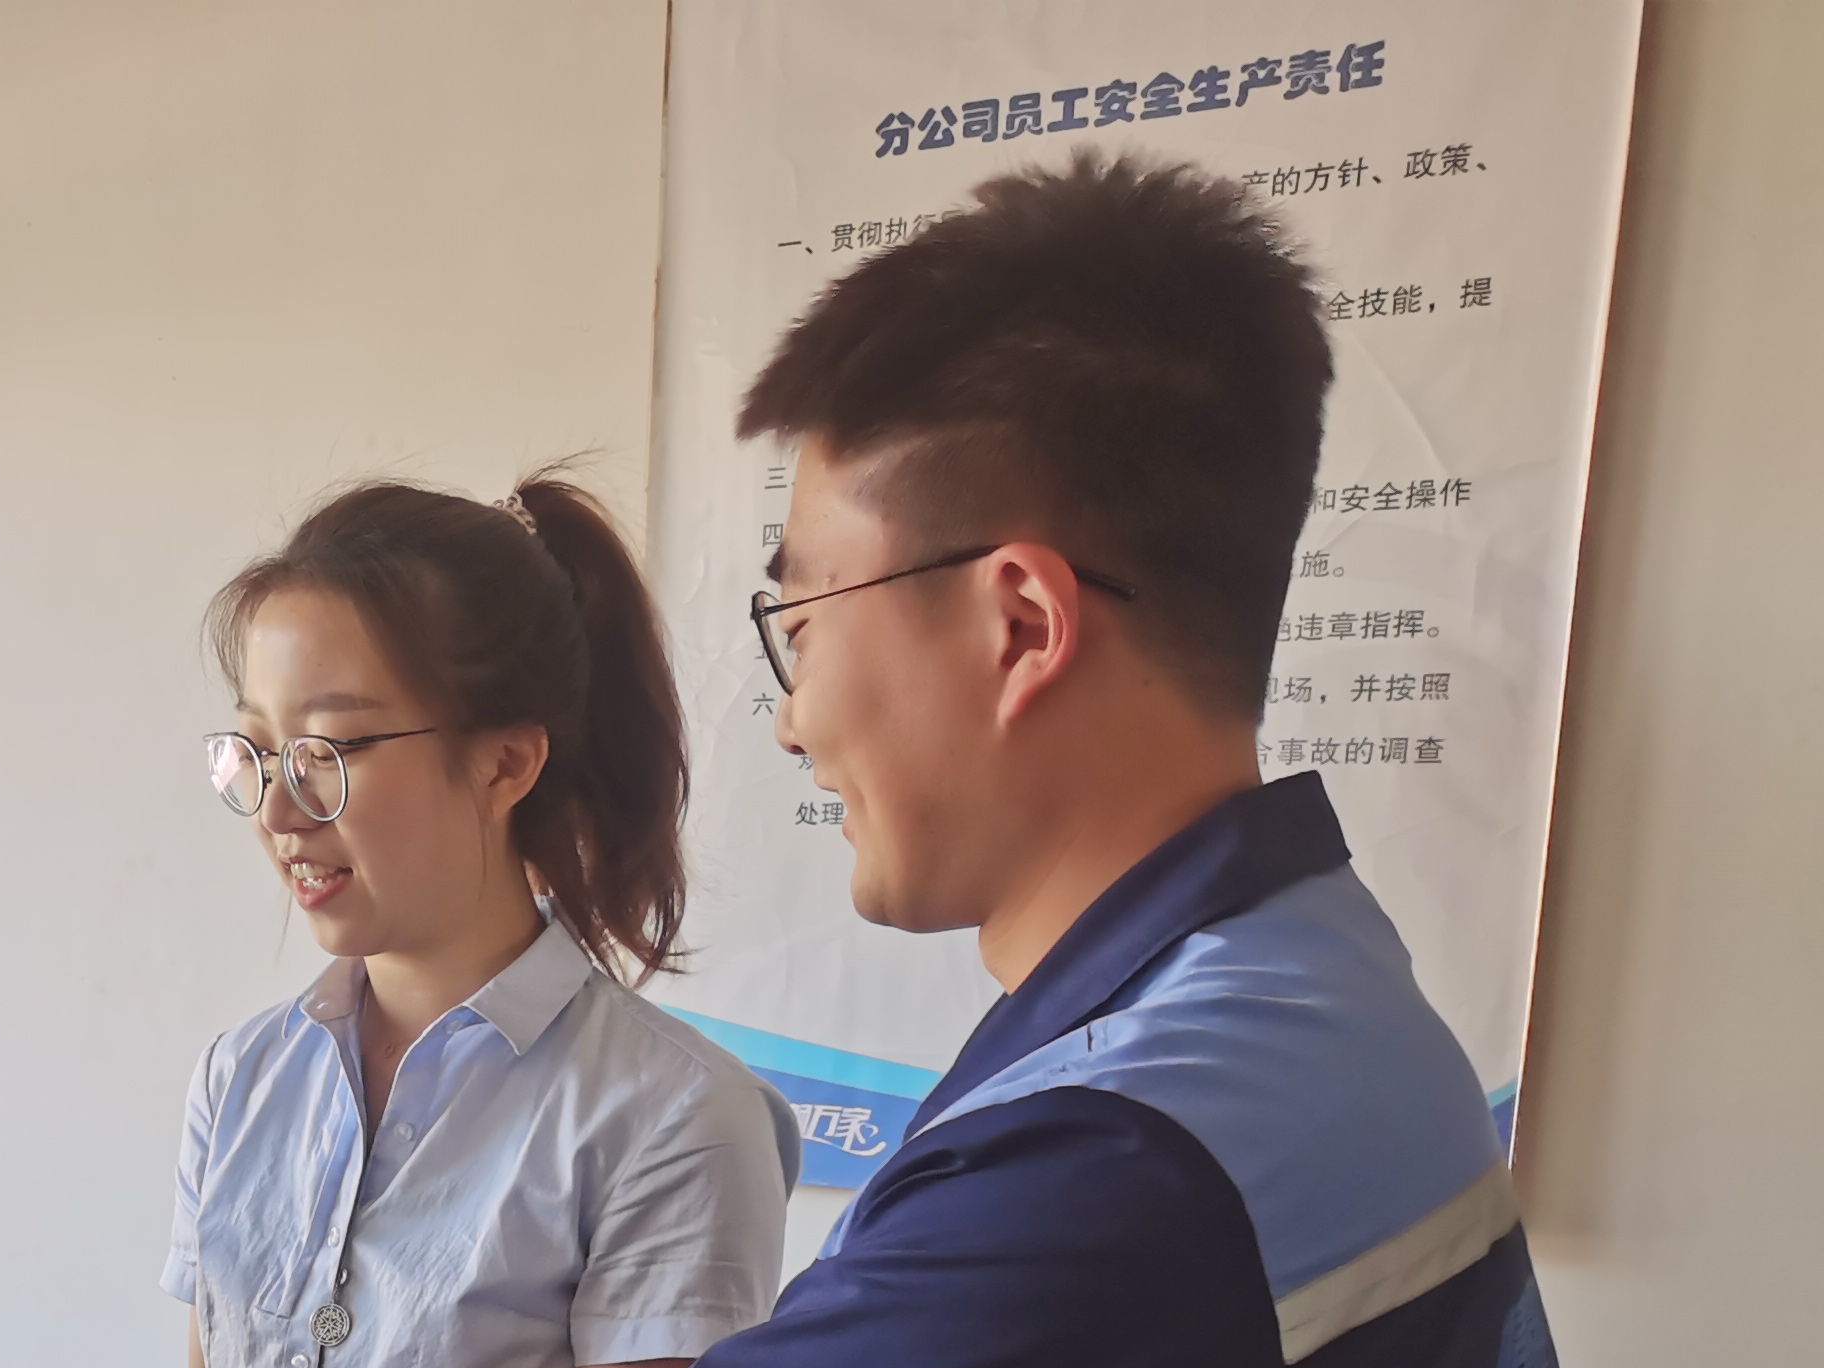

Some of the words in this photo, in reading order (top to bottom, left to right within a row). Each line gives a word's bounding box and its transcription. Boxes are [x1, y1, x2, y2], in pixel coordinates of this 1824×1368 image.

[874, 40, 1386, 158] 分公司员工安全生产责任
[1241, 142, 1488, 197] 产的方针、政策、
[794, 801, 845, 826] 处理
